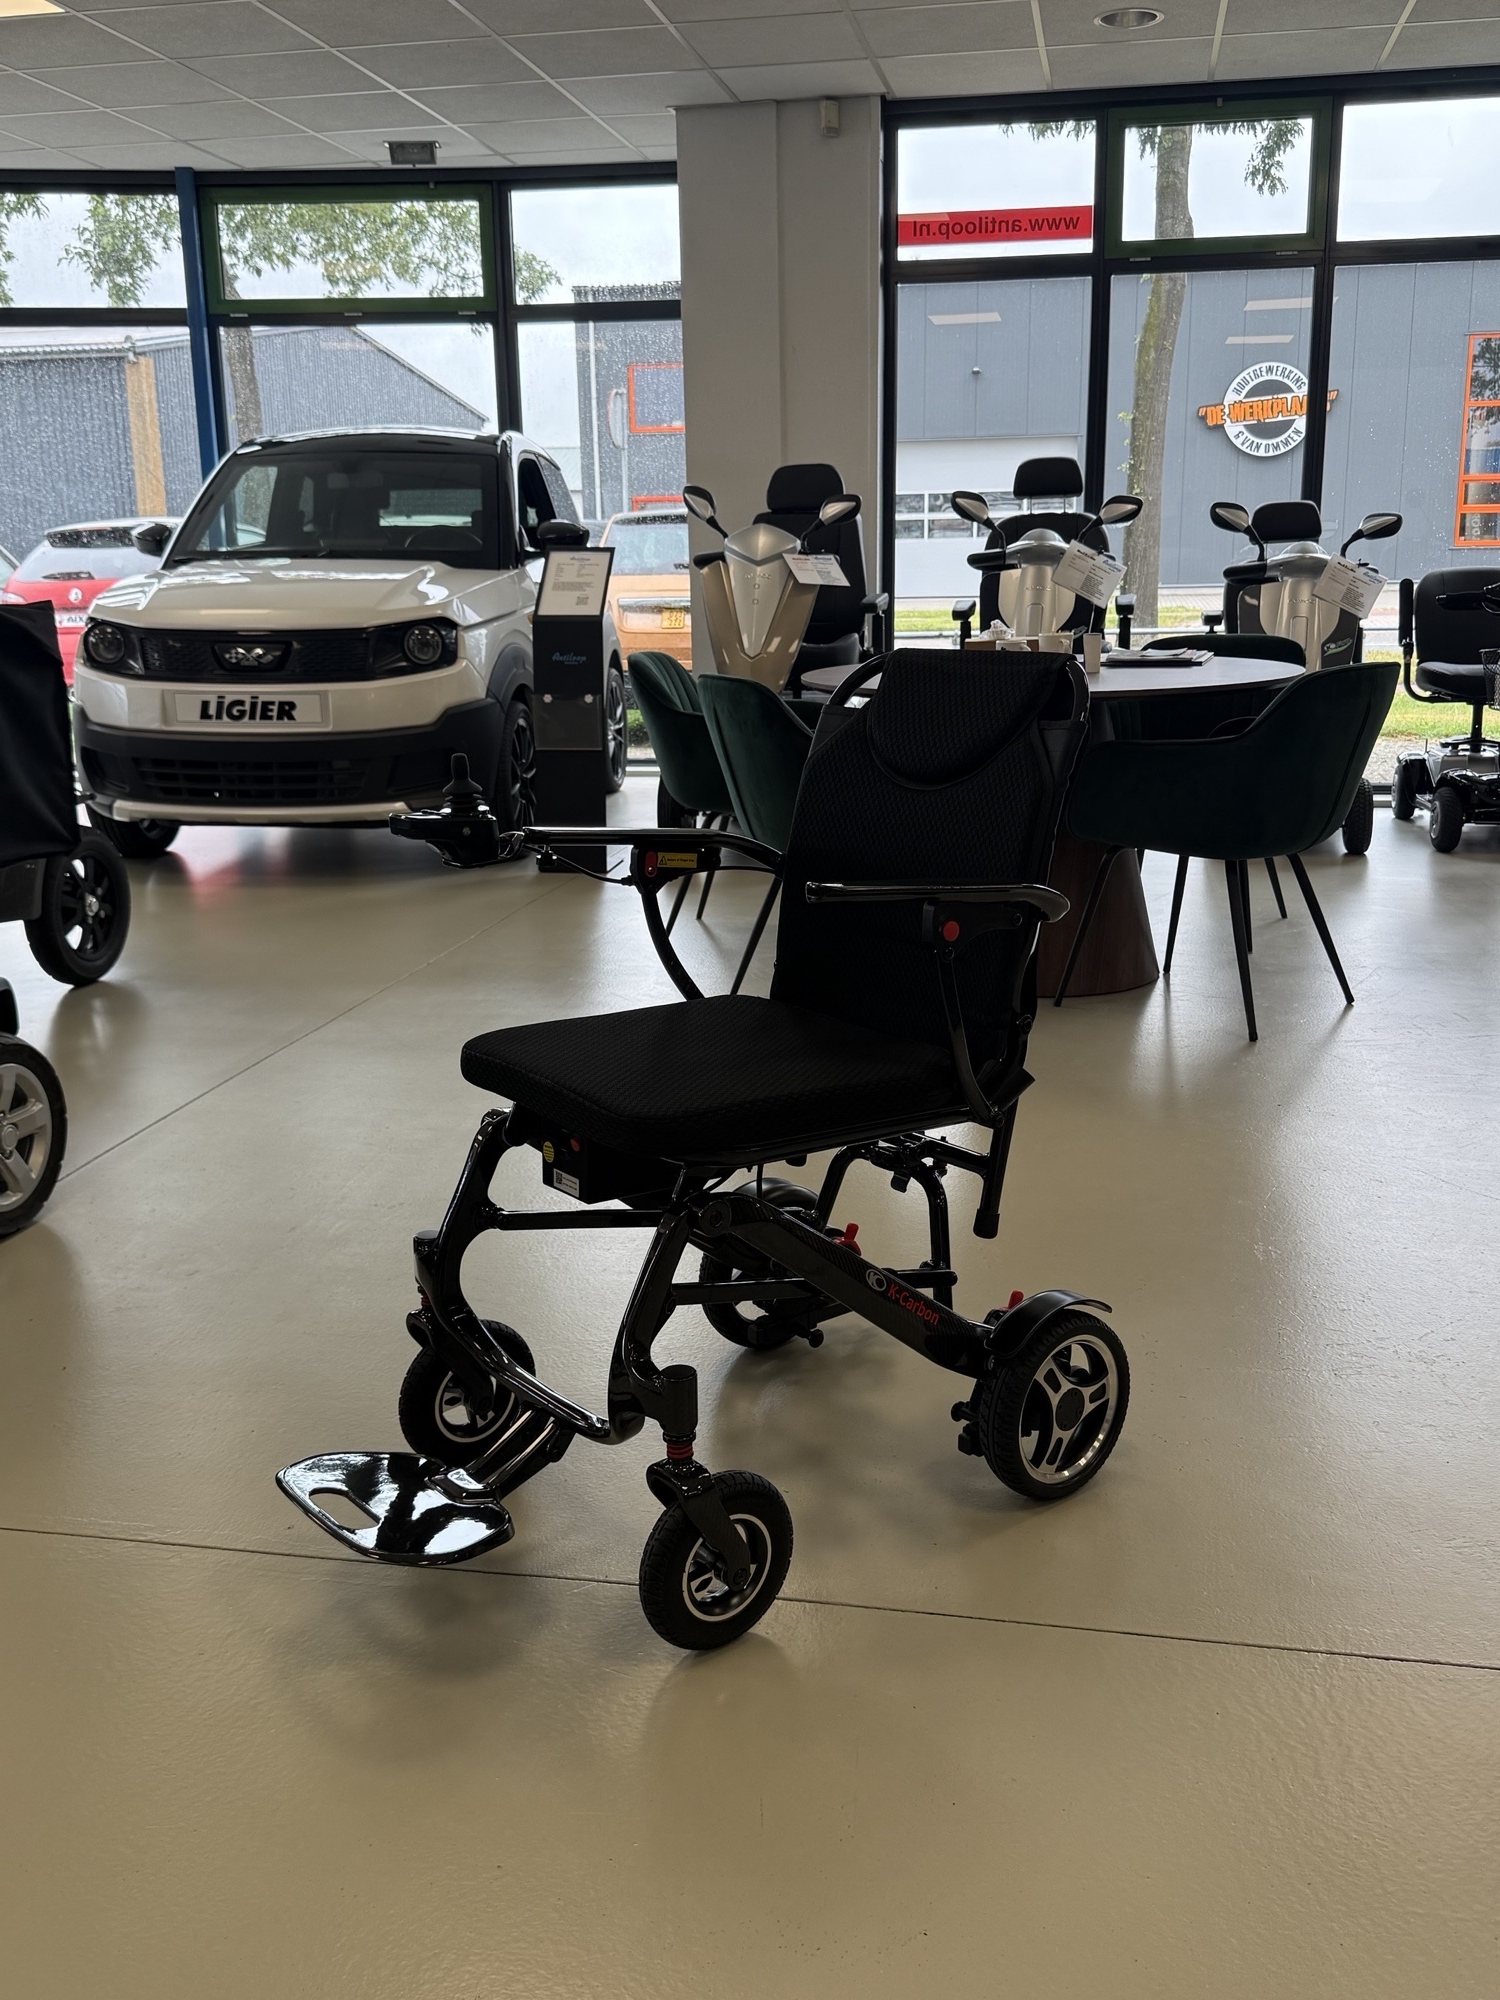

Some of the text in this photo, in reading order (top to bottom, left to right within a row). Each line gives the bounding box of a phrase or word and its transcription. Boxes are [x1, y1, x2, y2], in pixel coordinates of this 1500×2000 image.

[1232, 365, 1306, 396] HOUTBEWERKING
[1241, 436, 1262, 453] VAN
[1264, 428, 1303, 454] OMMEN
[888, 1283, 940, 1325] K-Carbon
